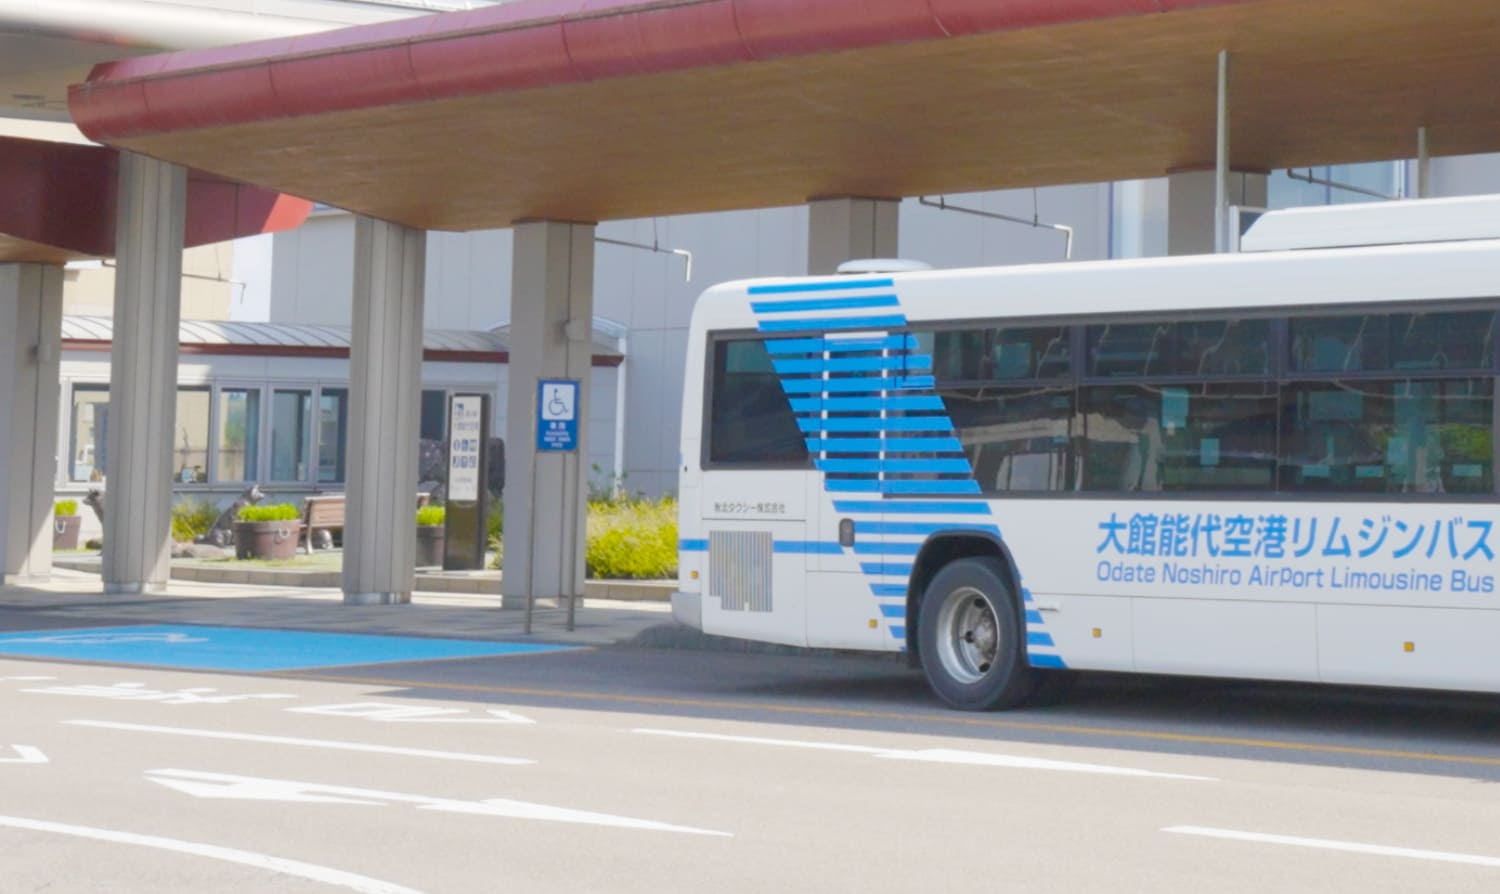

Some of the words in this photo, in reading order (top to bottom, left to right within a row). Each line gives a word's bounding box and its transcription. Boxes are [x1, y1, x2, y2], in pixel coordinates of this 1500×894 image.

[1096, 512, 1496, 561] 大館能代空港リムジンバス
[1096, 561, 1155, 583] Odate
[1162, 562, 1242, 586] Noshiro
[1330, 567, 1443, 592] Limousine
[1450, 569, 1495, 593] Bus
